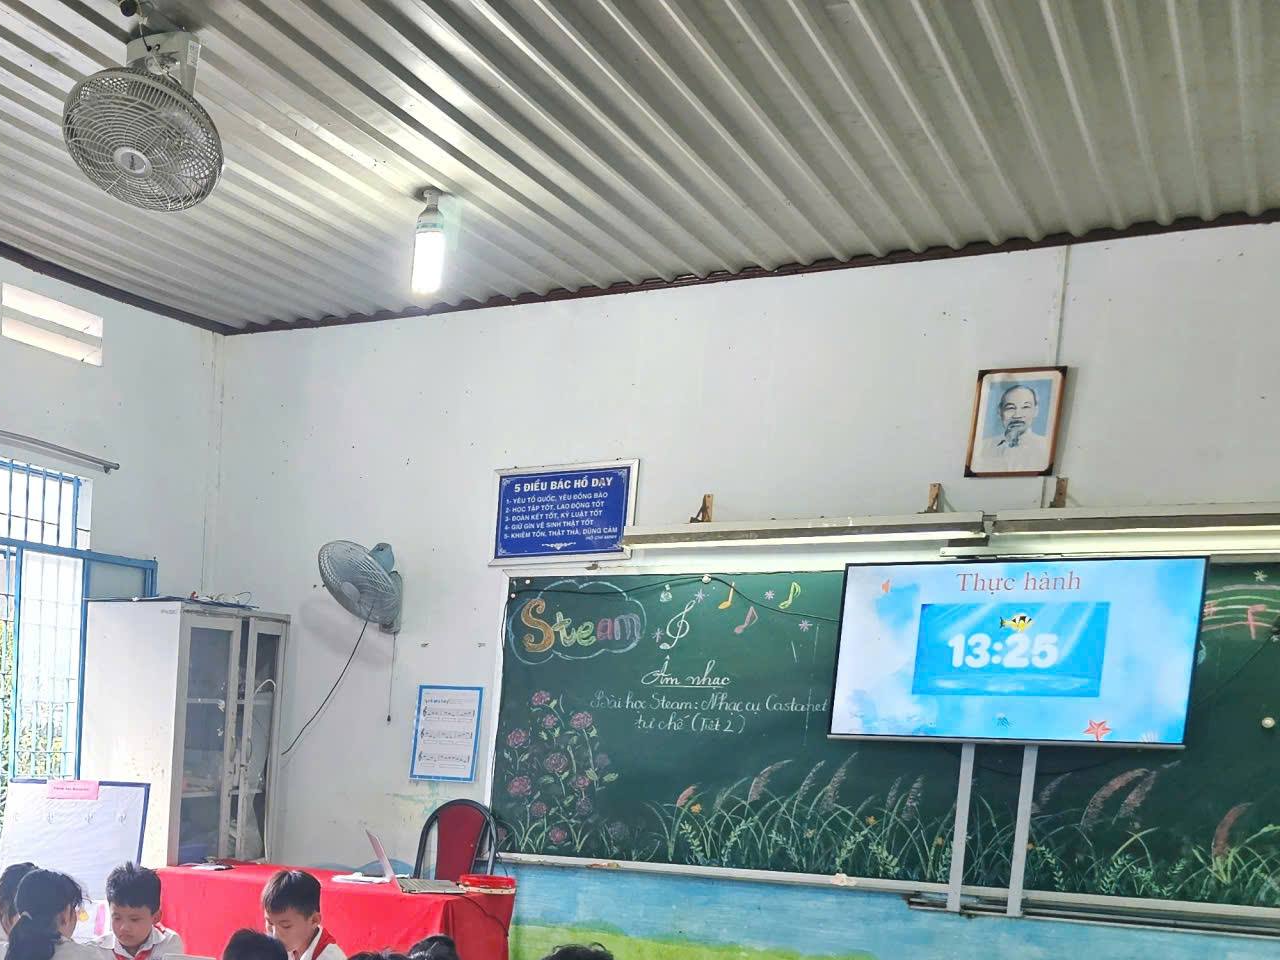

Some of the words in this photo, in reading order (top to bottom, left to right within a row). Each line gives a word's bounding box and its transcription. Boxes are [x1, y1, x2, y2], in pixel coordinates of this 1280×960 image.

[514, 484, 521, 493] 5
[523, 478, 547, 492] ĐIỀU
[550, 478, 571, 491] BÁC
[574, 475, 589, 489] HỒ
[557, 502, 570, 510] LAO
[956, 572, 1016, 595] Thực
[1024, 570, 1081, 591] hành
[520, 598, 641, 653] Steam
[947, 632, 1060, 669] 13:25
[641, 655, 681, 686] Âm
[685, 659, 731, 691] nhạc
[650, 693, 698, 712] Steam:
[701, 691, 743, 716] Nhạc
[745, 701, 761, 716] cụ
[765, 693, 829, 713] Castanet
[658, 714, 689, 731] chế
